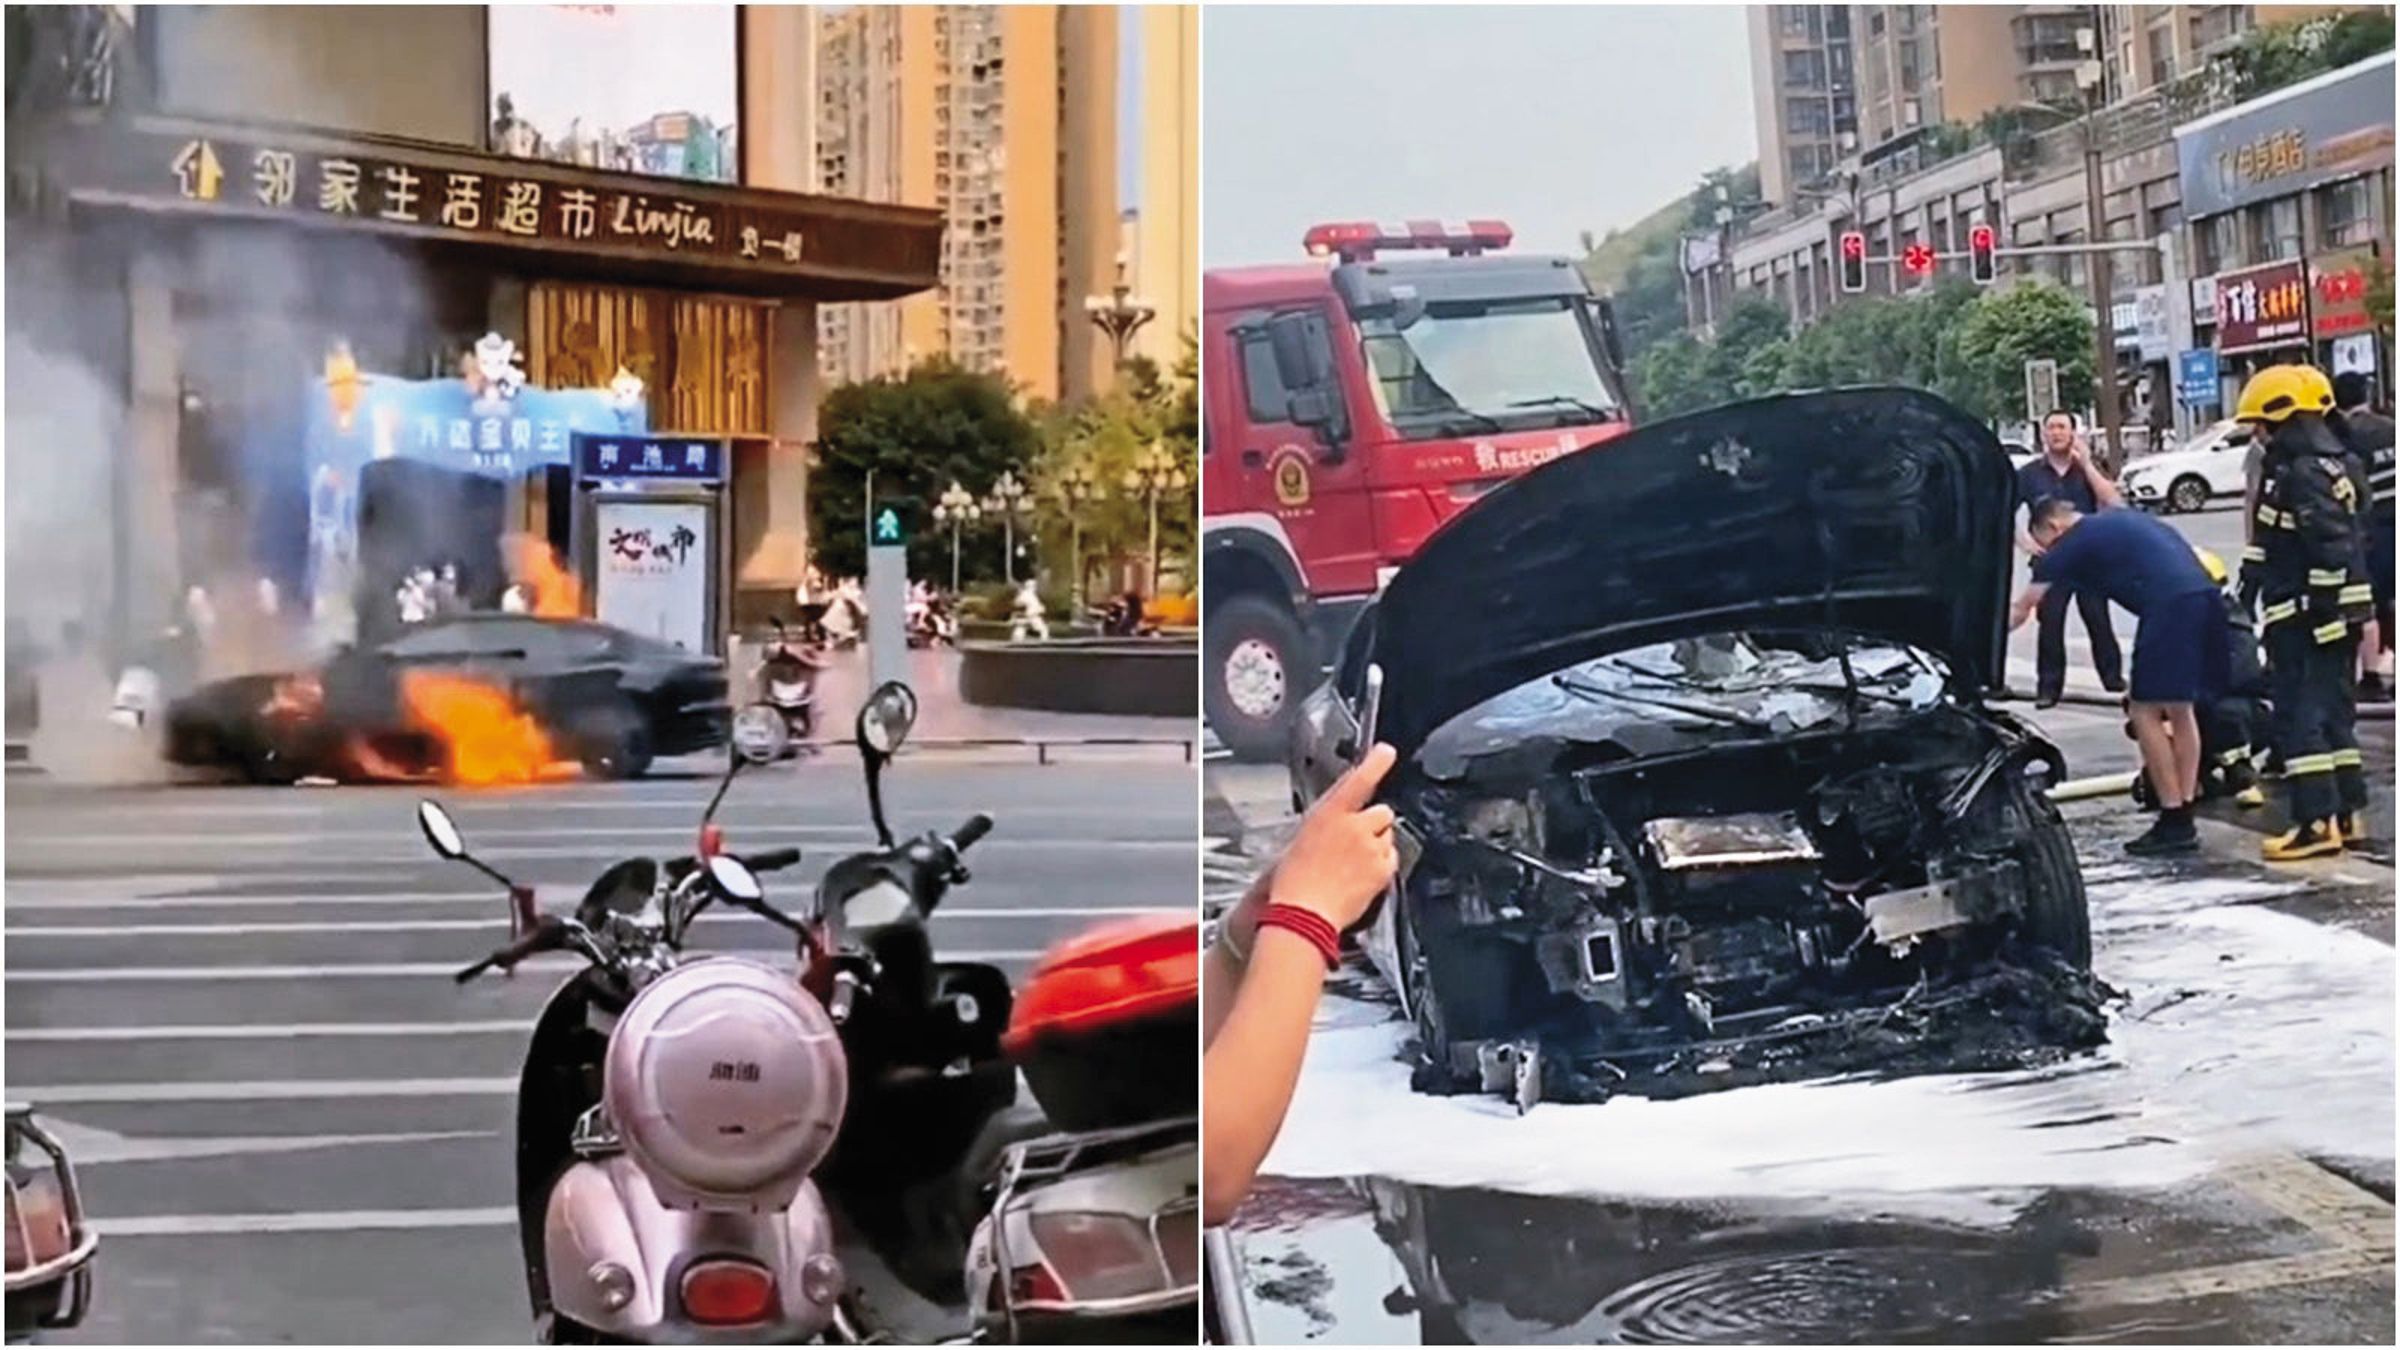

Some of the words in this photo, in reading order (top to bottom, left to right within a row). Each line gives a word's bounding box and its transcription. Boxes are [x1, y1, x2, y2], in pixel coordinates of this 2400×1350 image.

[253, 150, 596, 240] 邻家生活超市
[612, 196, 715, 248] Linjia
[1904, 245, 1933, 271] 25
